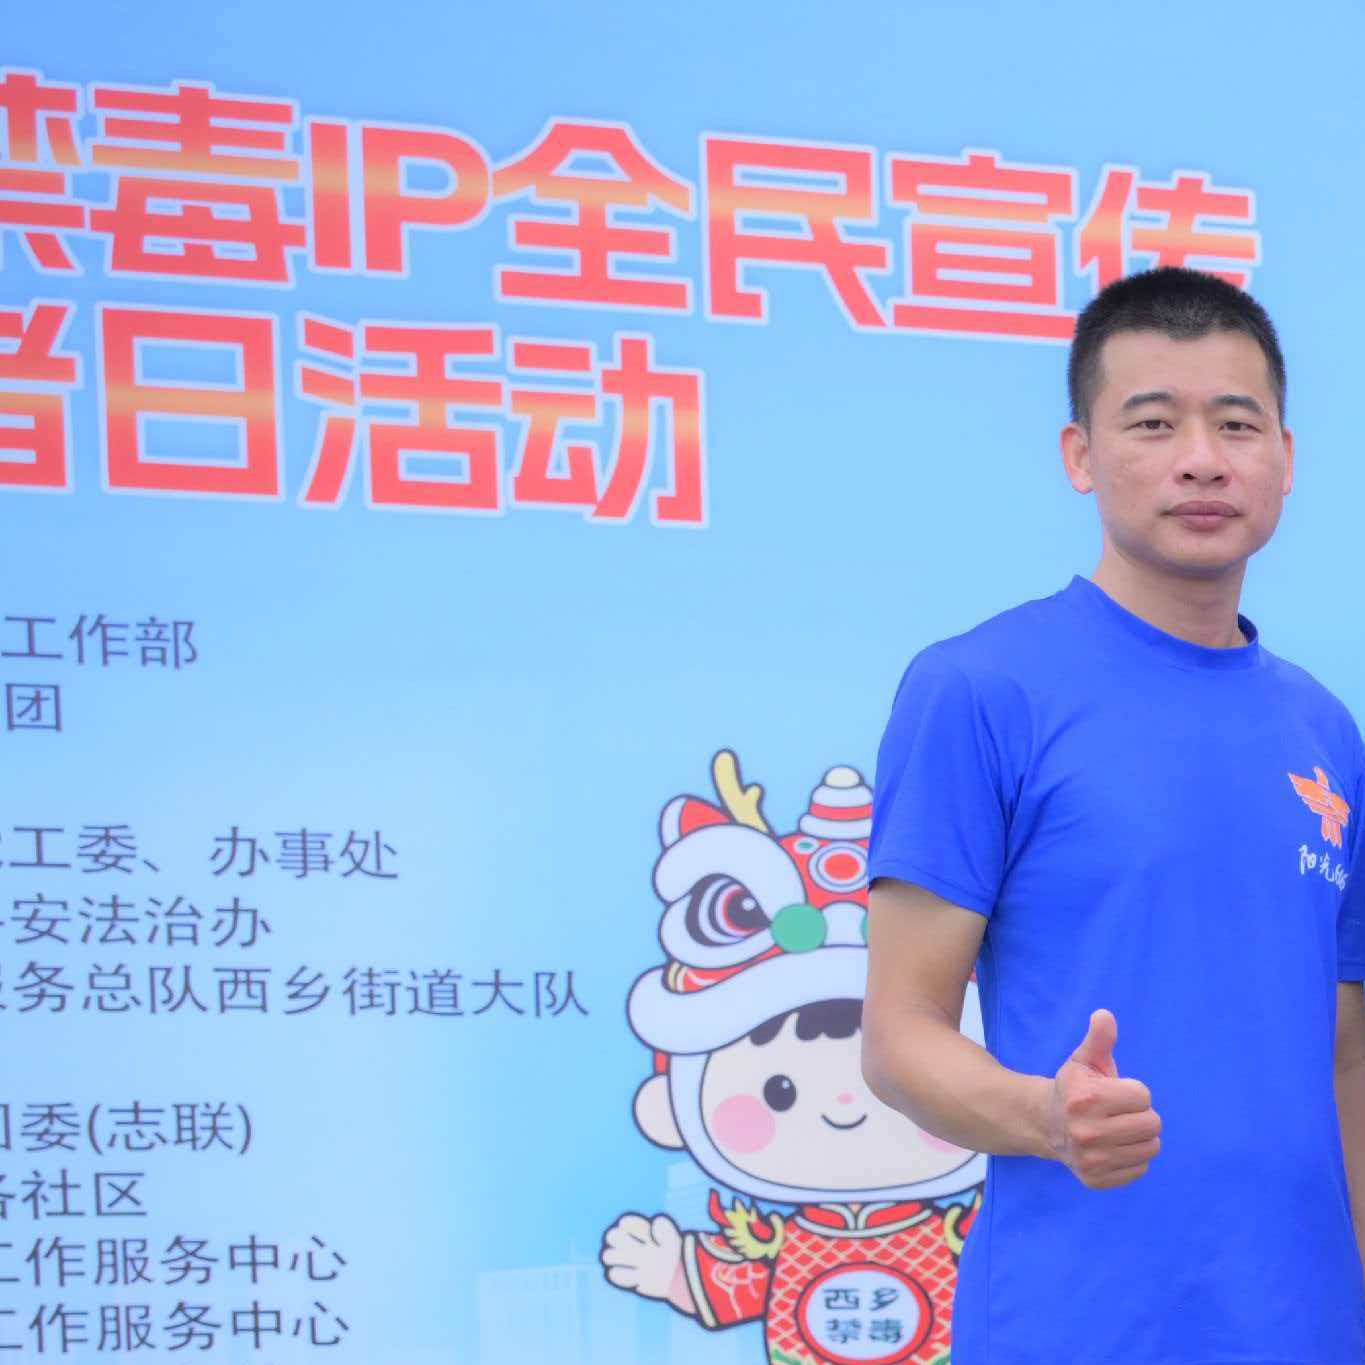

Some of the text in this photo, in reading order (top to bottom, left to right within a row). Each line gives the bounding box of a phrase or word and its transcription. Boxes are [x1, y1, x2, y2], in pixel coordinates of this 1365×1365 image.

[1, 613, 198, 670] 工作部
[5, 683, 62, 732] 团
[0, 824, 399, 880] 工委、办事处
[0, 892, 272, 948] 安法治办
[0, 960, 590, 1018] 务总队西乡街道大队
[0, 1100, 253, 1156] 委(志联)
[0, 1167, 148, 1220] 社区
